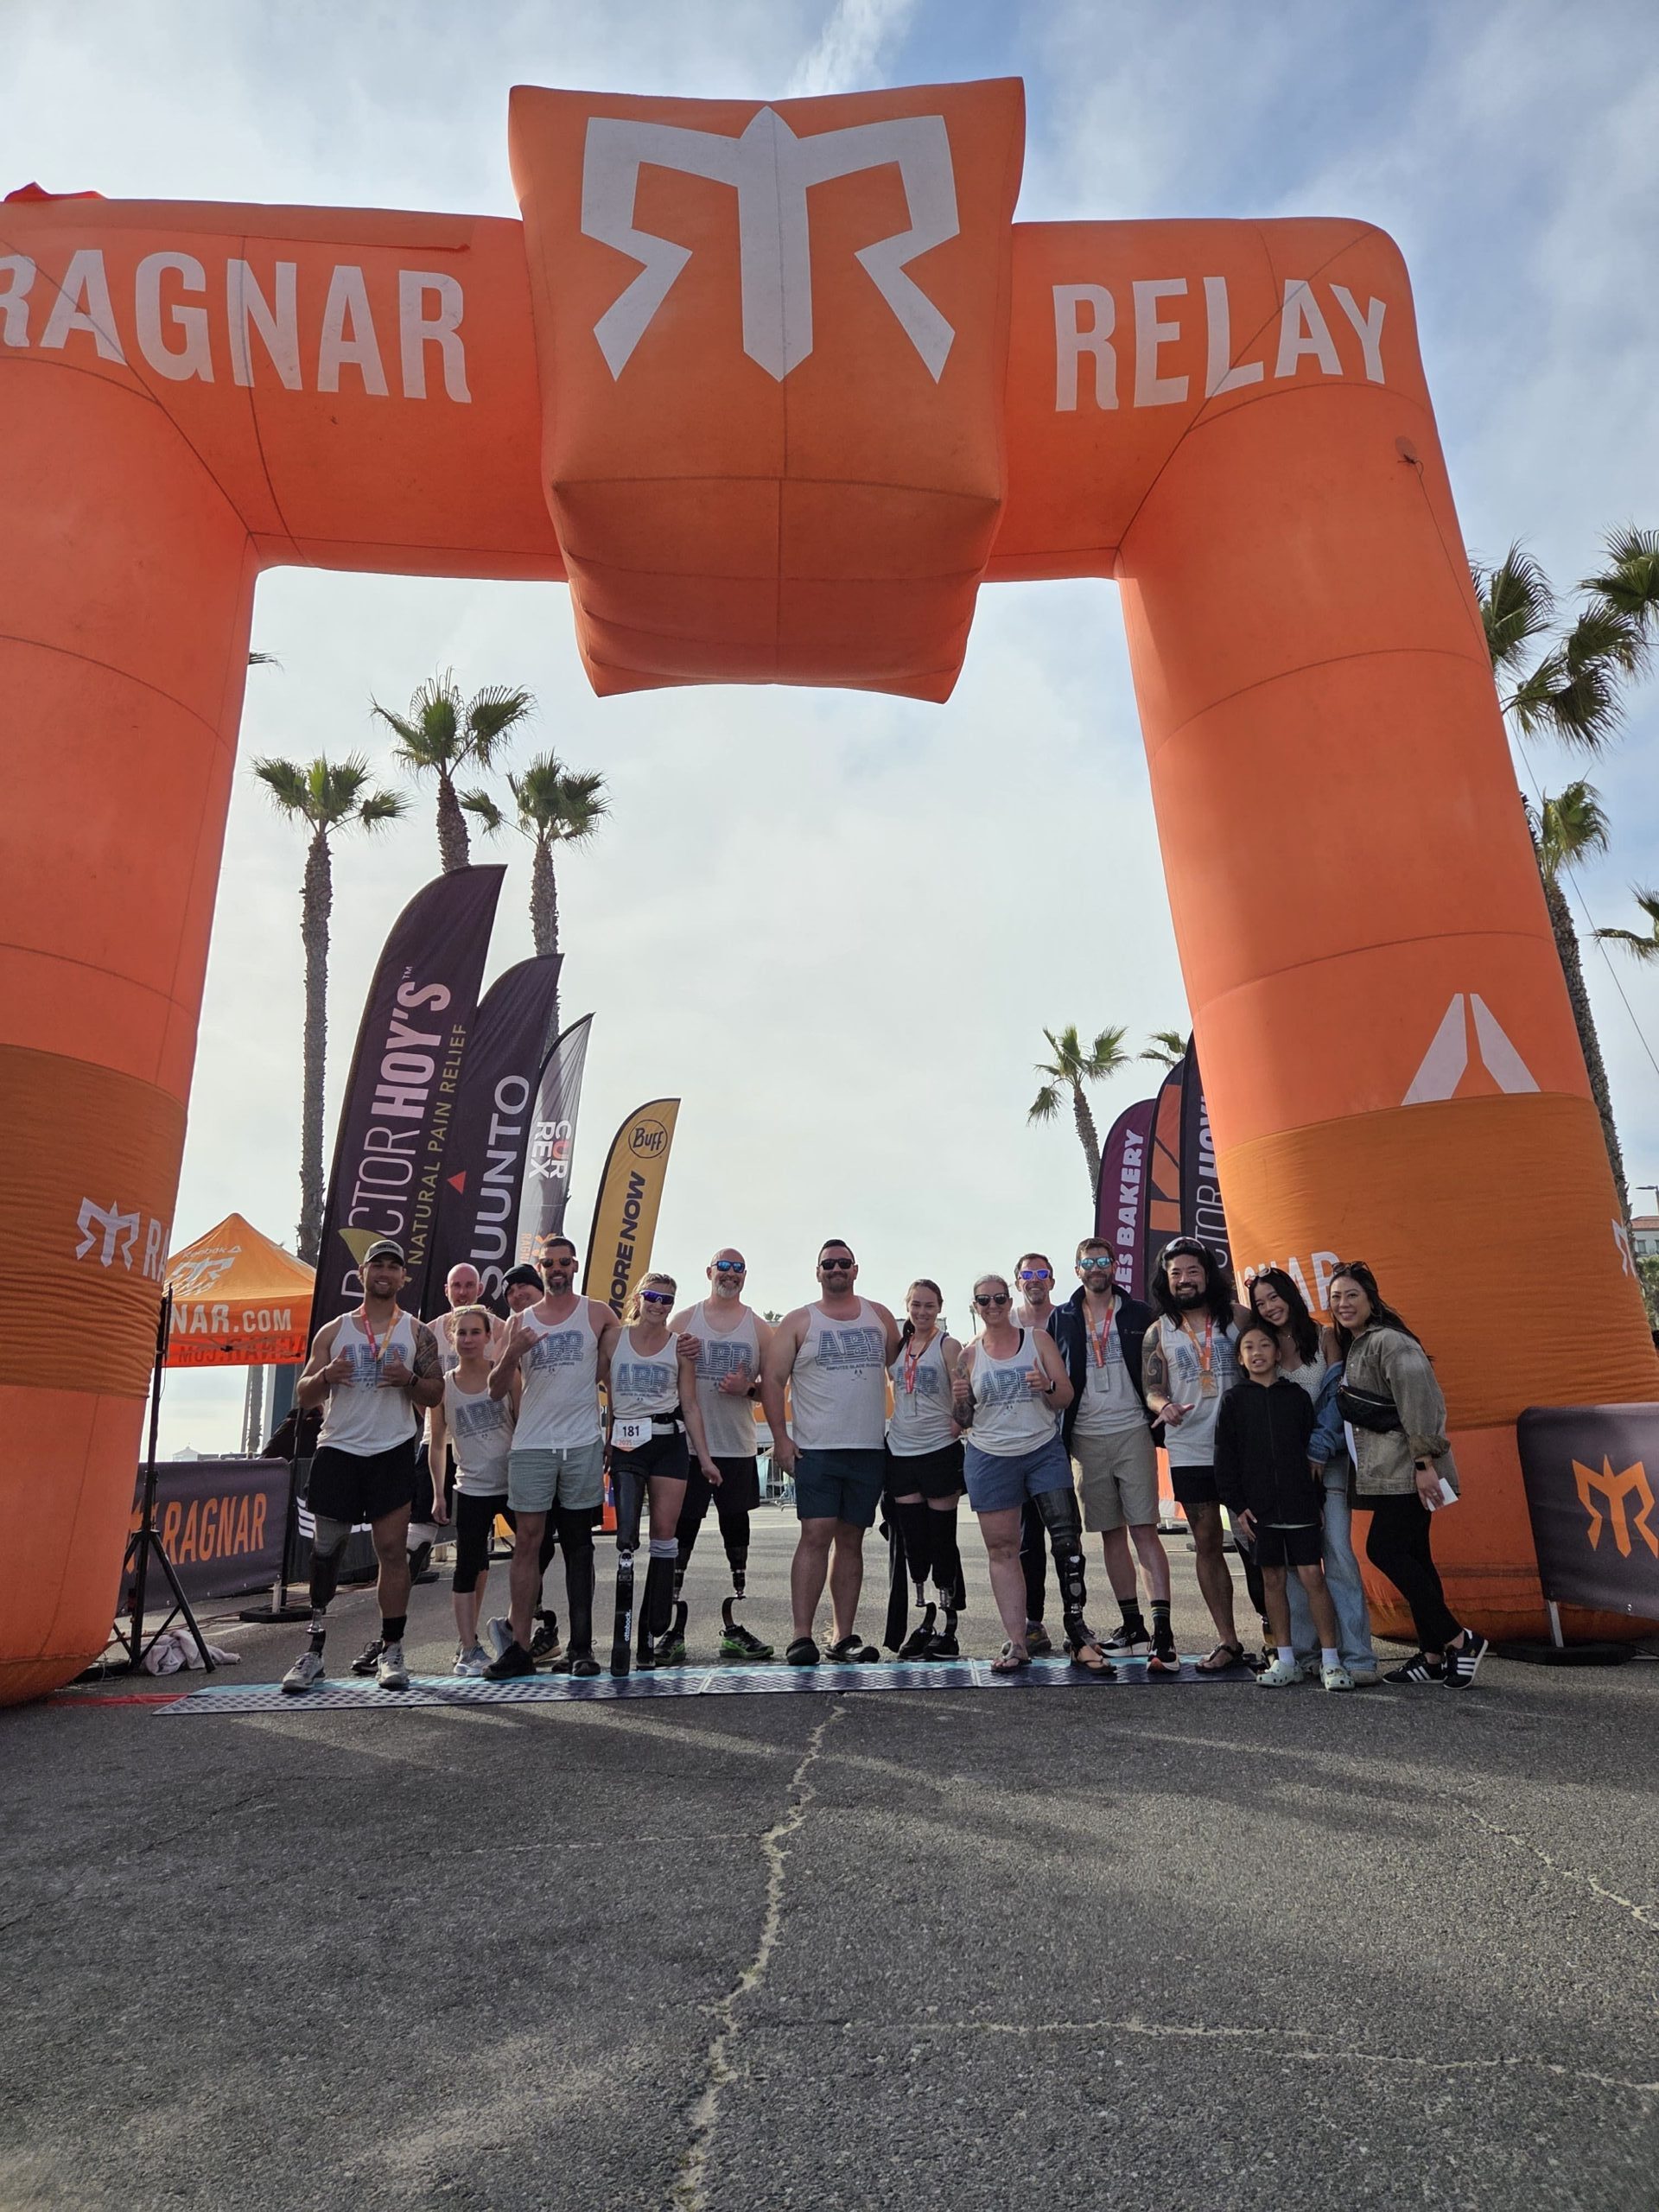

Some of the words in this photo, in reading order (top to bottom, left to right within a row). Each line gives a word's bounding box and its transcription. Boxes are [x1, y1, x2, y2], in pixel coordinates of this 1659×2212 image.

[0, 249, 472, 404] RAGNAR
[1052, 276, 1387, 412] RELAY
[439, 1023, 467, 1094] RELIEF
[427, 1102, 453, 1153] PAIN
[528, 1120, 556, 1179] REX
[407, 1160, 442, 1265] NATURAL
[468, 1075, 530, 1300] SUUNTO
[620, 1170, 646, 1242] NOW
[1116, 1128, 1145, 1248] BAKERY
[622, 1425, 641, 1437] 181
[162, 1492, 268, 1566] RAGNAR
